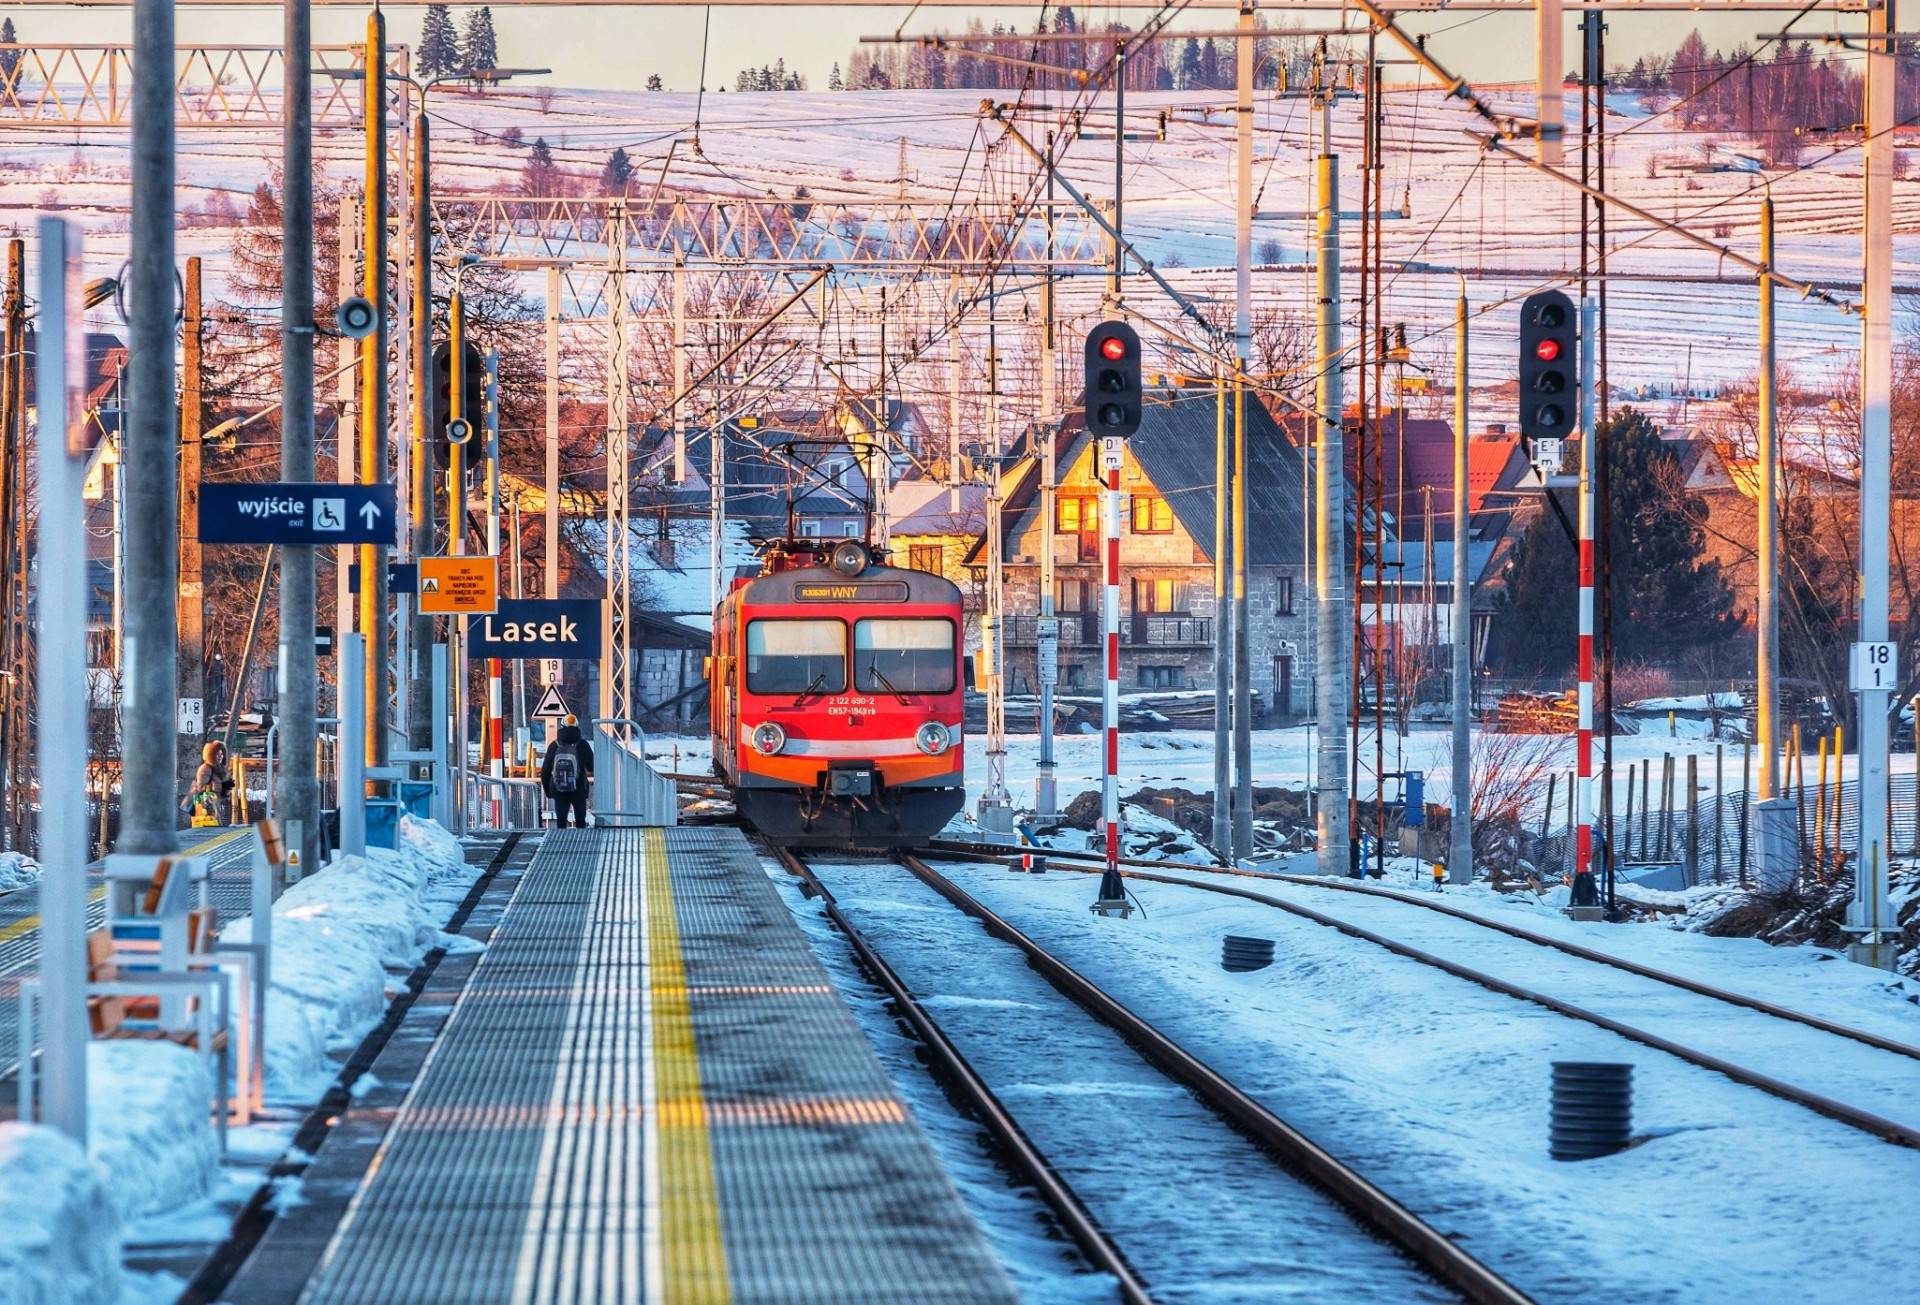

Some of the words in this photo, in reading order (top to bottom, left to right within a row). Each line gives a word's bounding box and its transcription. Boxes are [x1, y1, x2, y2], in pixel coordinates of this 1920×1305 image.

[1106, 456, 1117, 464] m
[237, 497, 304, 518] wyjście
[288, 519, 304, 527] exit
[831, 586, 857, 598] WNY
[485, 615, 578, 642] Lasek
[1869, 645, 1889, 664] 18
[547, 660, 558, 671] 18
[549, 672, 556, 682] 0
[1874, 667, 1880, 687] 1
[183, 701, 200, 715] 18
[187, 720, 193, 733] 0
